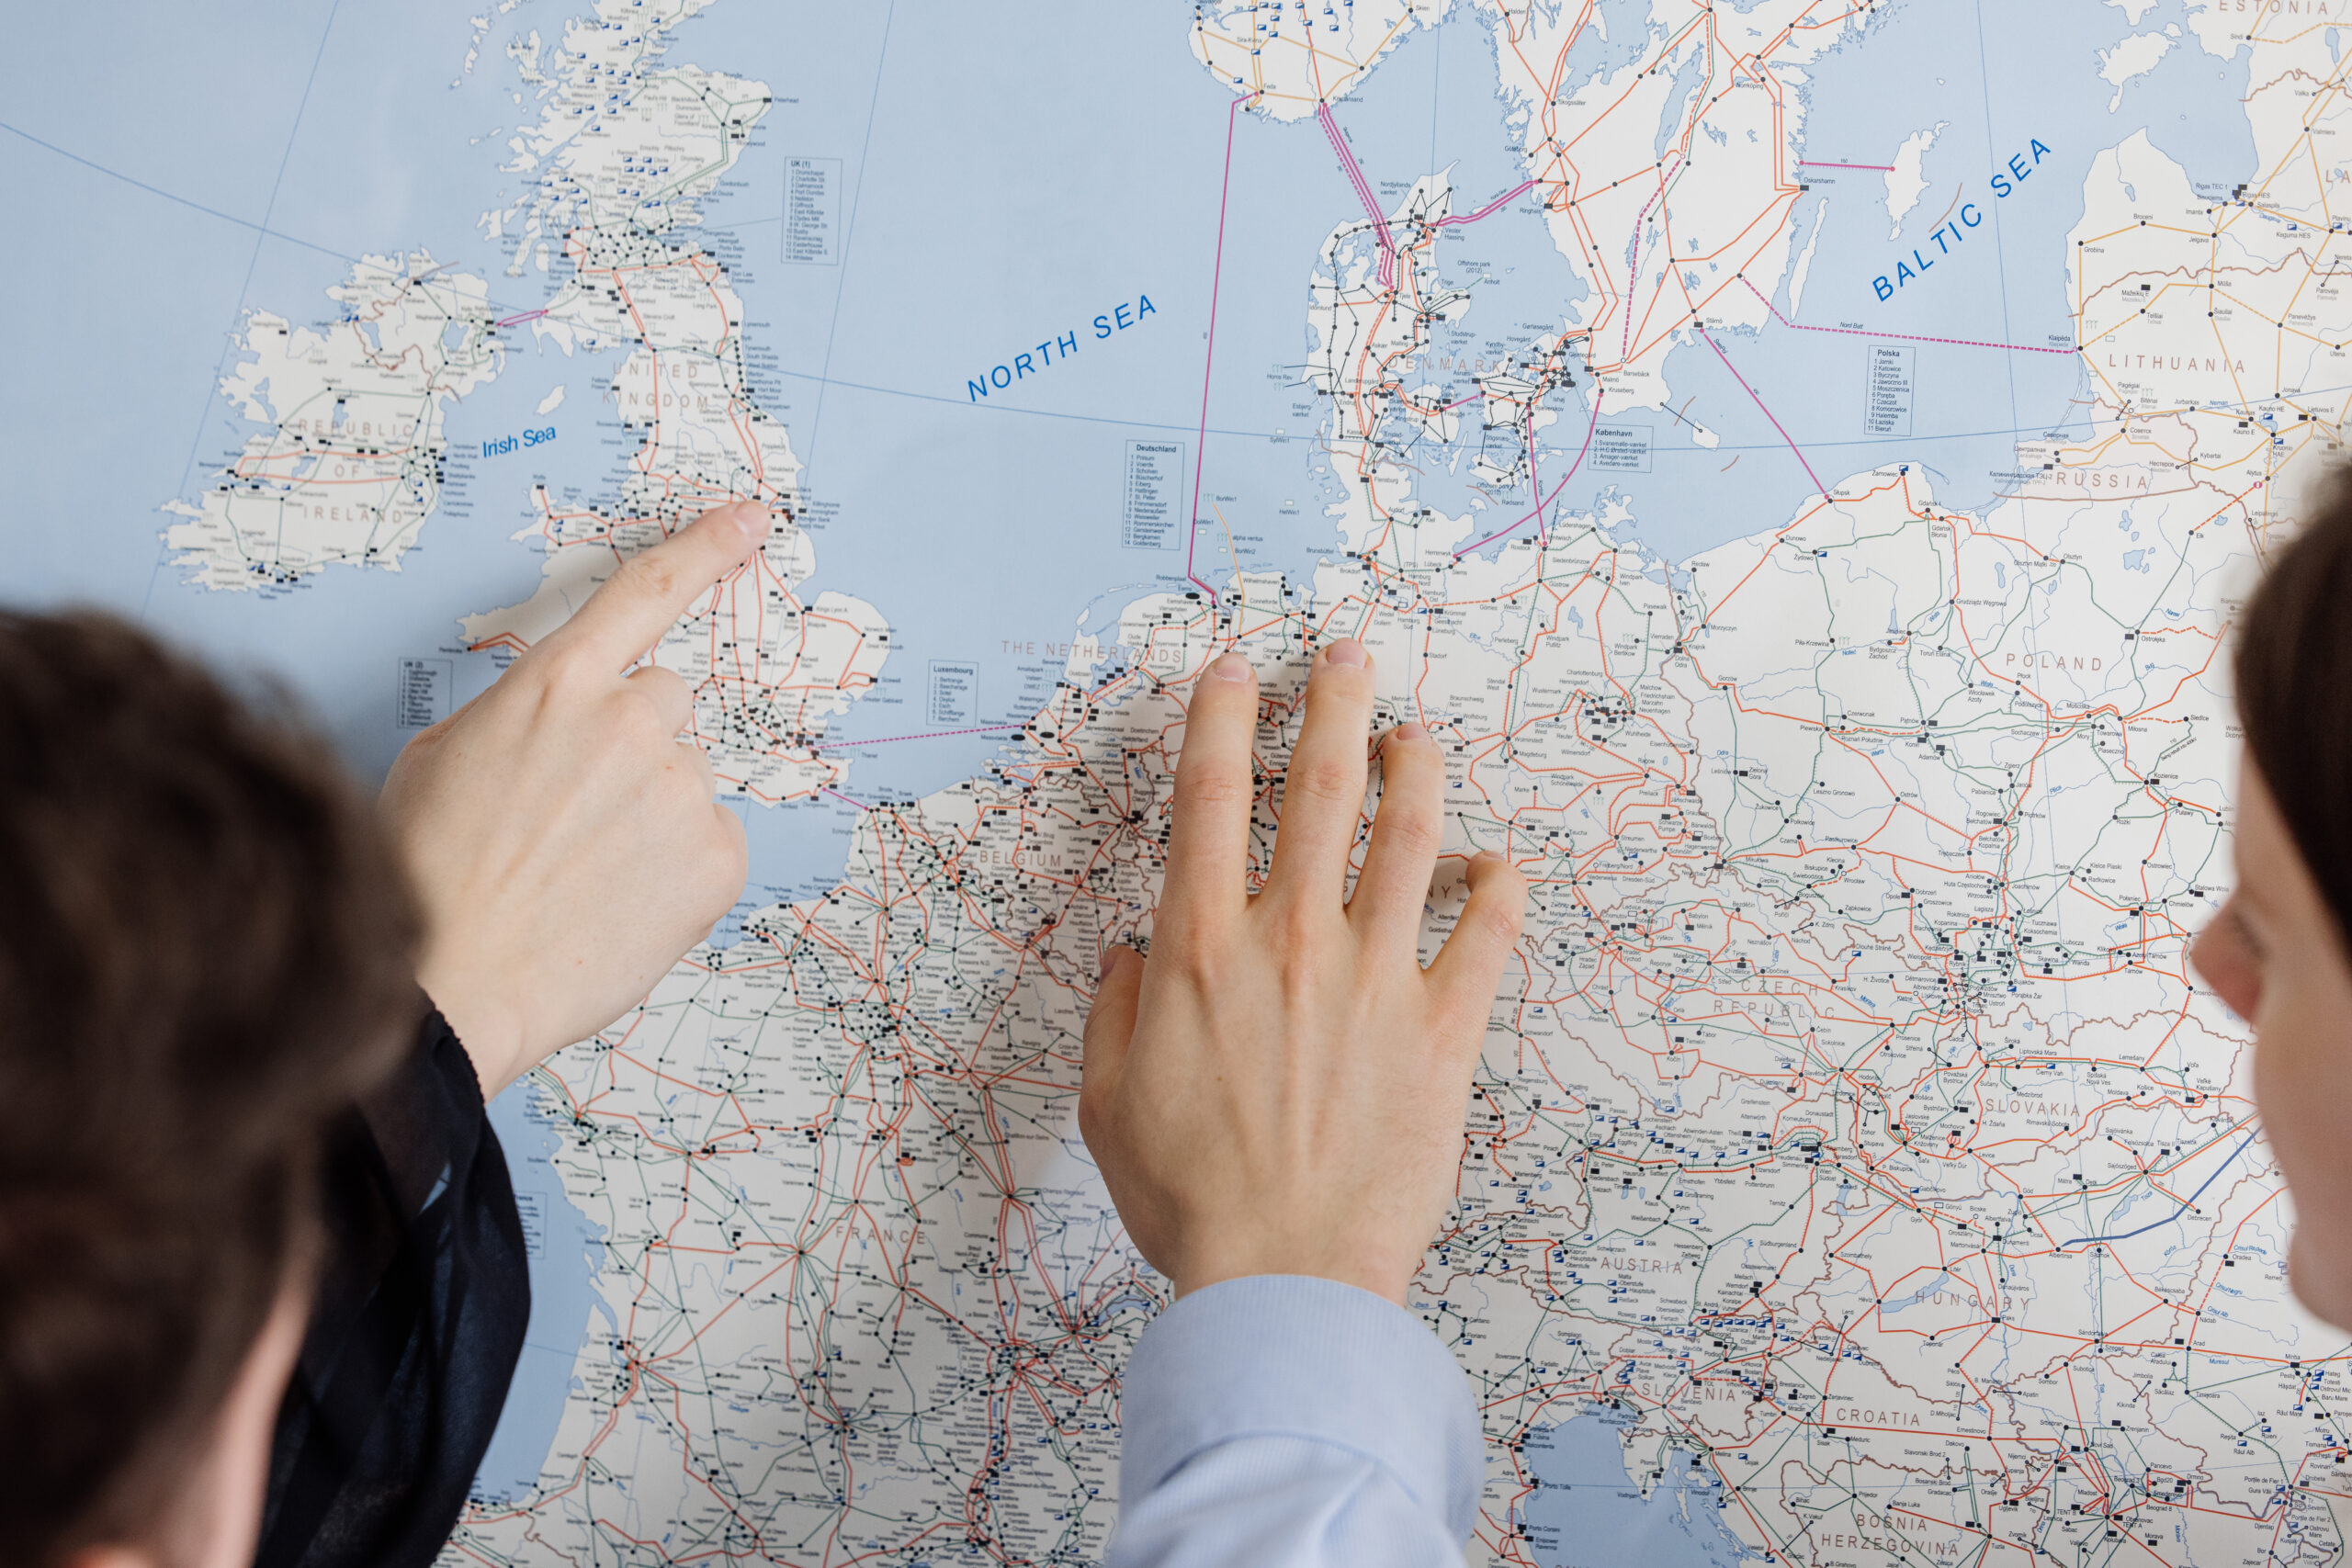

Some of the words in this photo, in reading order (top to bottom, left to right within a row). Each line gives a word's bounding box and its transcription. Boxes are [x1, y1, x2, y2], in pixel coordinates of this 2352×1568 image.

[2219, 0, 2328, 15] ESTONIA
[1871, 203, 1984, 302] BALTIC
[1990, 138, 2051, 198] SEA
[967, 331, 1078, 402] NORTH
[1093, 294, 1157, 339] SEA
[1877, 349, 1900, 357] Polska
[613, 362, 698, 379] UNITED
[1388, 356, 1500, 373] DENMARK
[2109, 353, 2245, 374] LITHUANIA
[602, 390, 709, 409] KINGDOM
[299, 418, 413, 438] REPUBLIC
[1595, 429, 1633, 437] København
[481, 435, 519, 458] Irish
[522, 425, 557, 450] Sea
[1136, 444, 1176, 453] Deutschland
[334, 464, 361, 478] OF
[2056, 472, 2147, 490] RUSSIA
[303, 505, 402, 524] IRELAND
[1002, 640, 1035, 655] THE
[1046, 643, 1182, 662] NETHERLANDS
[933, 665, 973, 675] Luxembourg
[2006, 653, 2102, 671] POLAND
[979, 851, 1062, 867] BELGIUM
[1742, 979, 1819, 996] CZECH
[1713, 999, 1835, 1020] REPUBLIC
[1985, 1098, 2081, 1118] SLOVAKIA
[836, 1225, 925, 1244] FRANCE
[1600, 1257, 1683, 1274] AUSTRIA
[1915, 1292, 2030, 1310] HUNGARY
[1642, 1382, 1736, 1402] SLOVENIA
[1837, 1409, 1920, 1426] CROATIA
[1856, 1514, 1928, 1531] BOSNIA
[1821, 1534, 1959, 1556] HERZEGOVINA
